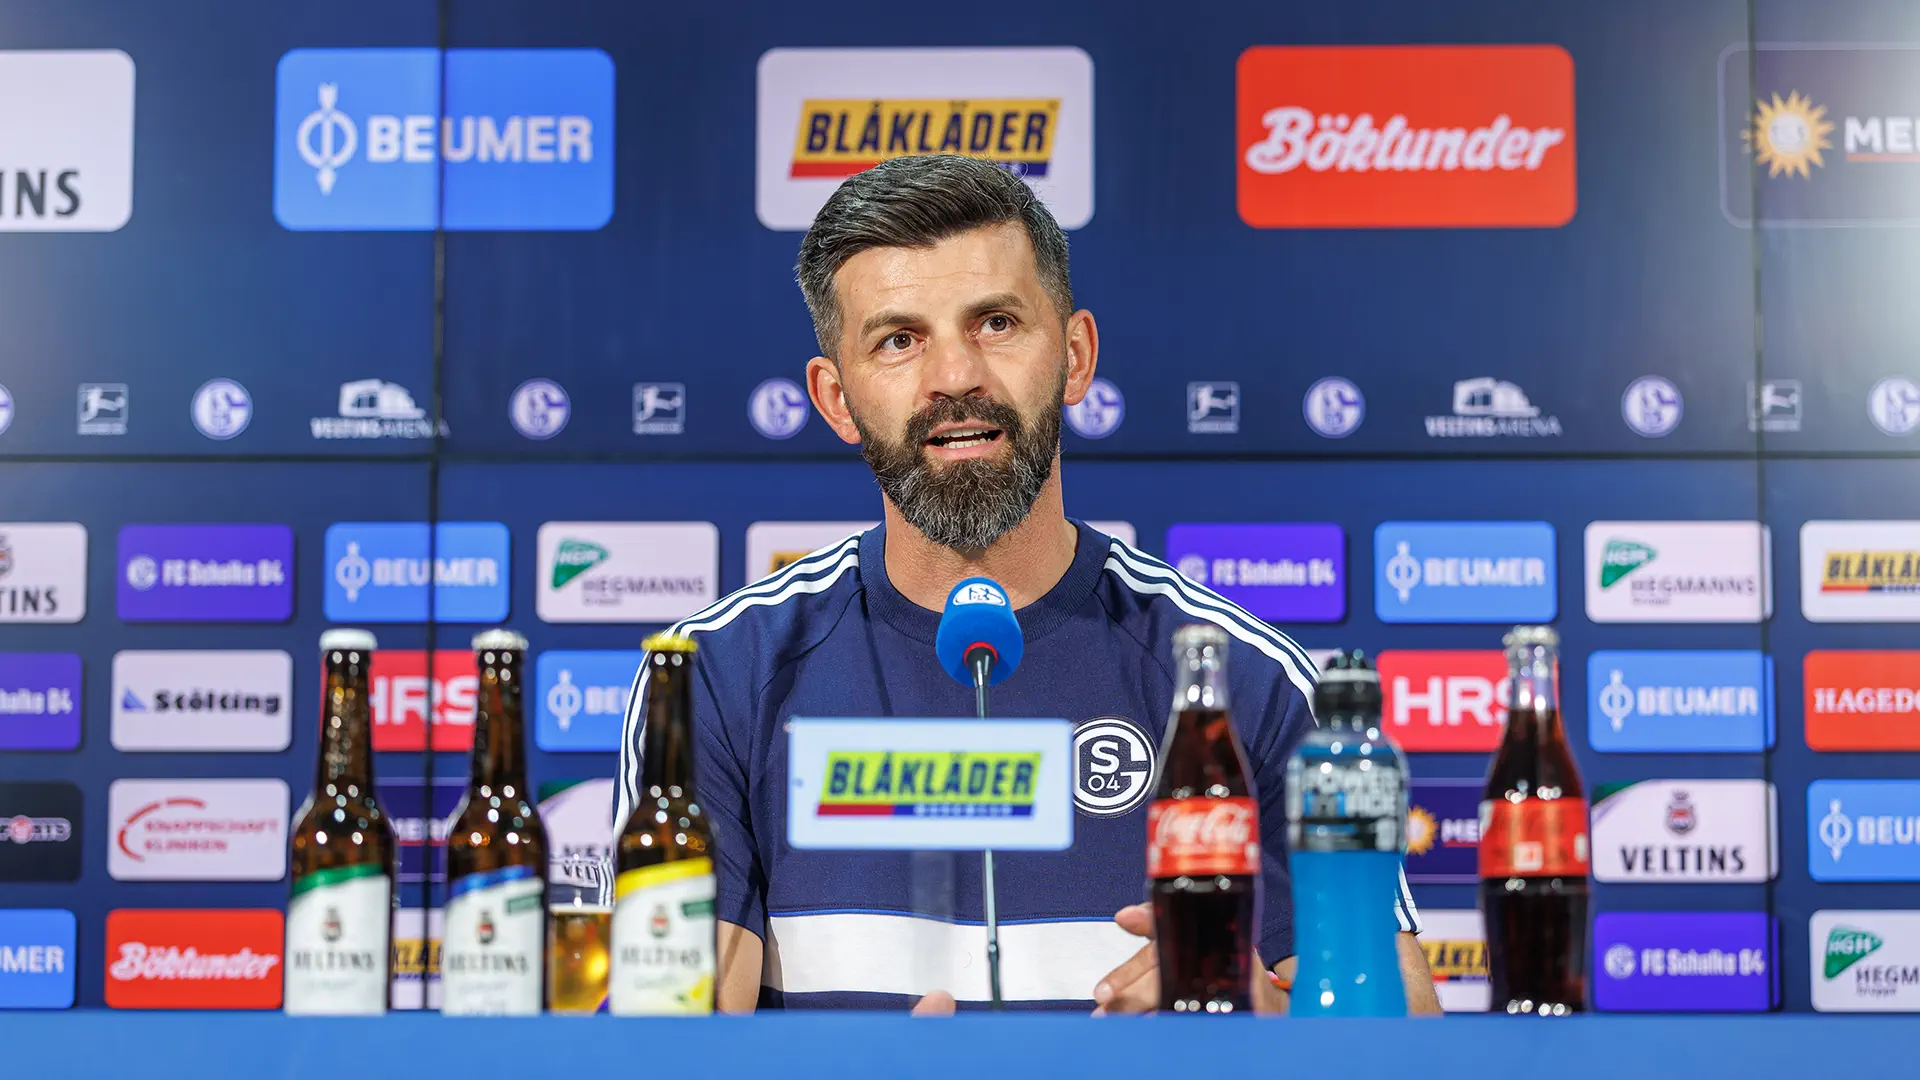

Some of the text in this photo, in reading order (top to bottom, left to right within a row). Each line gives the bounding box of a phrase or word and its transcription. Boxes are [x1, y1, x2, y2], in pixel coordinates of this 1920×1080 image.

[367, 117, 593, 163] BEUMER
[805, 102, 1048, 153] BLÅKLÄDER
[1246, 106, 1565, 174] Böklunder
[1844, 115, 1920, 153] ME
[372, 558, 498, 586] BEUMER
[1425, 558, 1545, 586] BEUMER
[1637, 686, 1758, 715] BEUMER
[828, 751, 1035, 796] BLÅKLÄDER
[1857, 815, 1920, 845] BEU
[1620, 846, 1746, 874] VELTINS
[0, 946, 64, 973] MER
[110, 942, 278, 980] Böklunder
